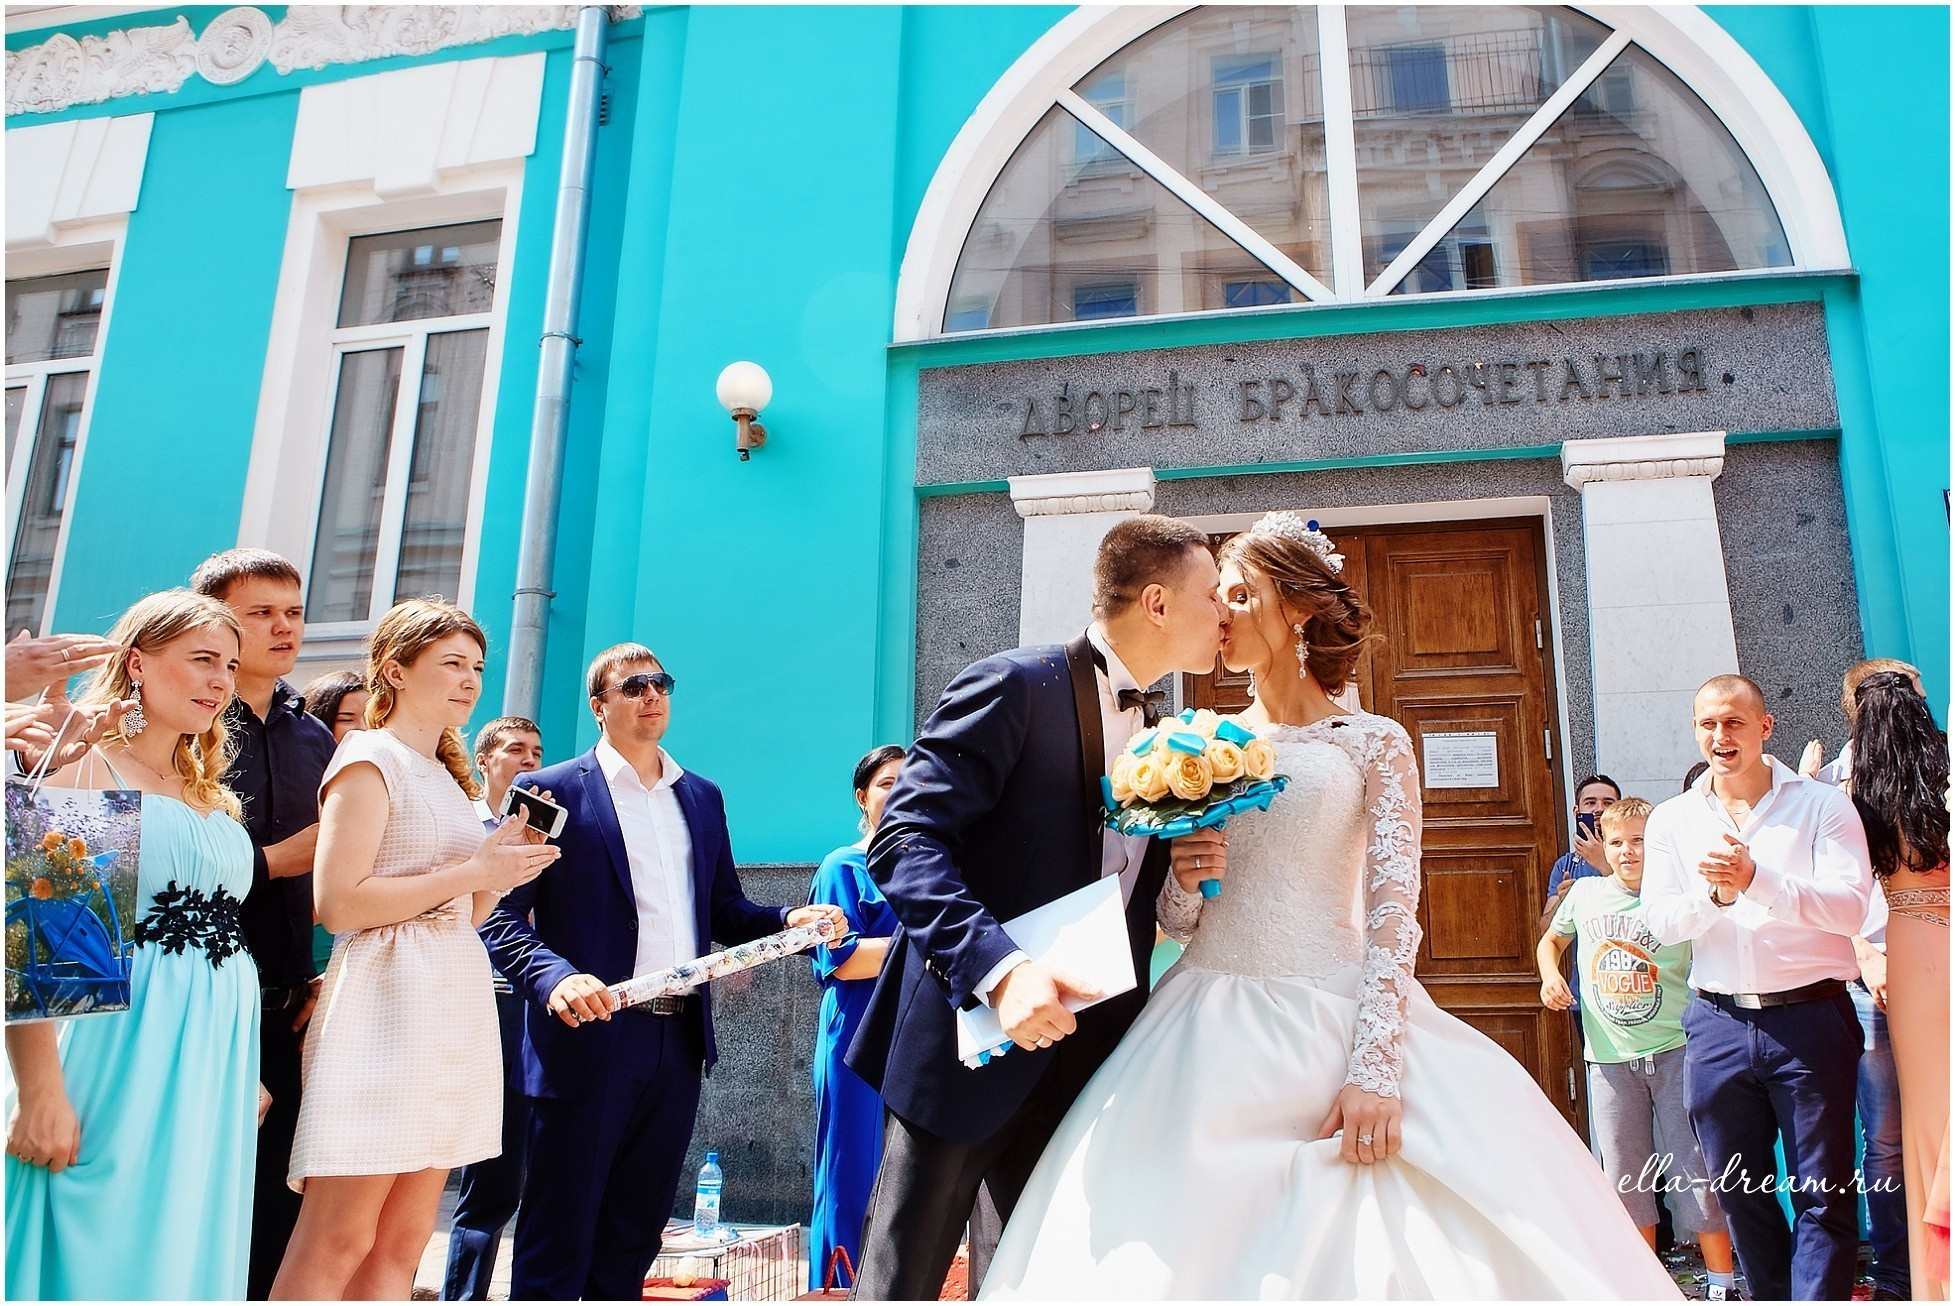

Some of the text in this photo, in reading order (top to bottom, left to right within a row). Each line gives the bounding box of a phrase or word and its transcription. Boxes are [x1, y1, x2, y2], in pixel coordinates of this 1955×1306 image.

[1018, 347, 1708, 446] ДВОРЕЦ БРАКОСОЧЕТАНИЯ
[1599, 973, 1652, 993] VOGUE
